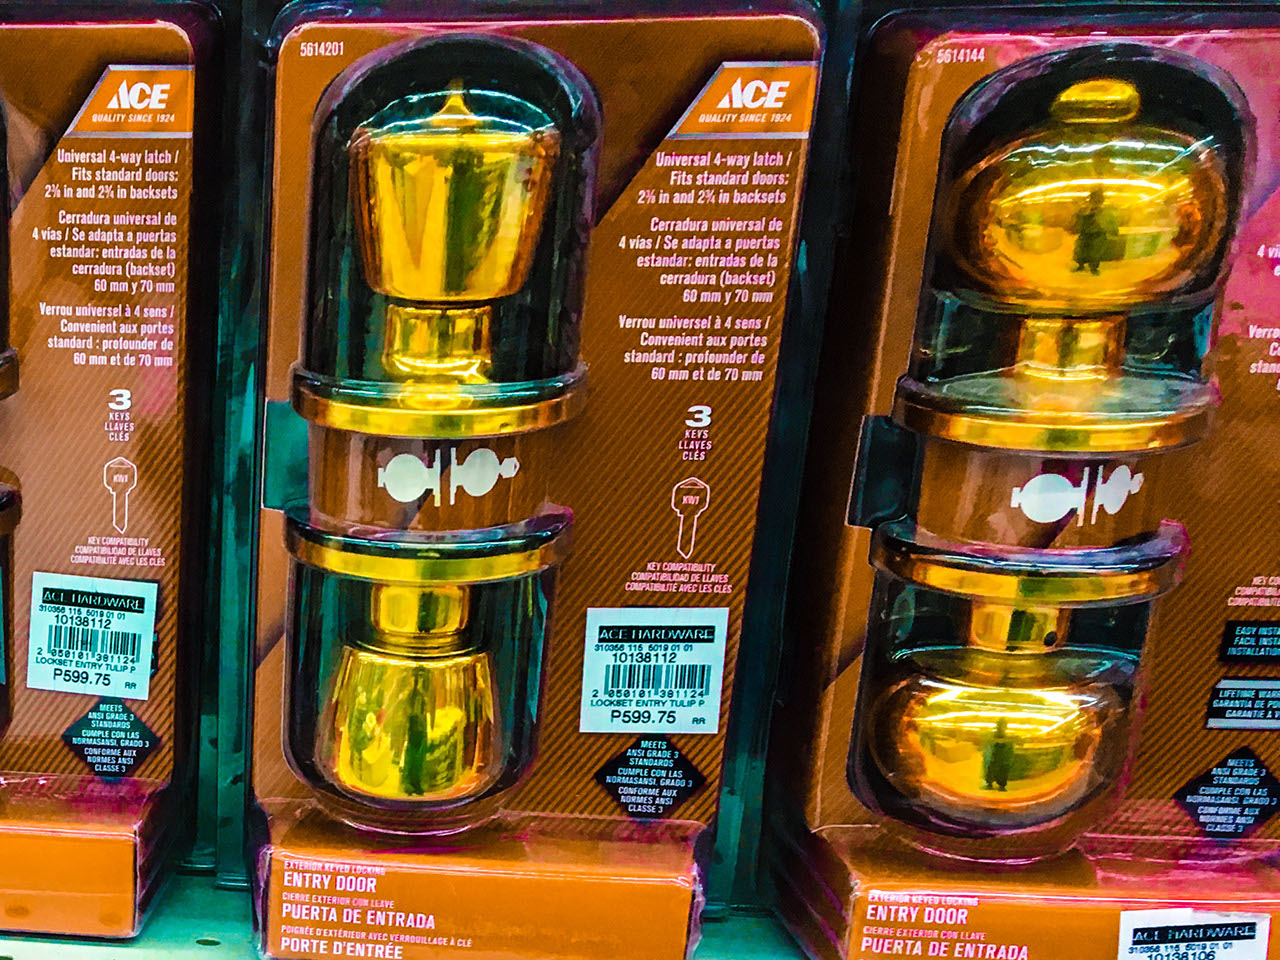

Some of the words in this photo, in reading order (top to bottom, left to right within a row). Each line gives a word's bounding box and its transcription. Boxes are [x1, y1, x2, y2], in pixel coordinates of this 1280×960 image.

[299, 41, 345, 57] 5614201
[936, 47, 985, 64] 5614144
[107, 79, 170, 109] ACE
[717, 78, 789, 108] ACE
[92, 113, 126, 122] QUALITY
[128, 114, 152, 122] SINCE
[156, 113, 175, 122] 1924
[699, 114, 736, 123] QUALITY
[739, 114, 766, 123] SINCE
[770, 114, 791, 123] 1924
[656, 151, 710, 167] Universal
[714, 152, 750, 169] 4-way
[753, 152, 783, 167] latch
[670, 171, 693, 185] Fits
[696, 172, 749, 186] standard
[752, 172, 789, 186] doors:
[659, 190, 670, 203] in
[673, 191, 694, 204] and
[719, 191, 730, 204] in
[733, 190, 786, 204] backsets
[651, 218, 708, 232] Cerradura
[711, 218, 766, 232] universal
[768, 218, 783, 232] de
[619, 236, 626, 249] 4
[664, 236, 678, 249] Se
[681, 236, 721, 252] adapta
[725, 239, 732, 250] a
[735, 237, 780, 252] puertas
[637, 254, 692, 268] estandar:
[696, 254, 746, 268] entradas
[750, 254, 764, 268] de
[767, 254, 778, 268] la
[660, 271, 716, 285] cerradura
[720, 271, 775, 287] (backset)
[683, 289, 697, 303] 60
[701, 292, 721, 303] mm
[724, 293, 731, 306] y
[735, 289, 749, 303] 70
[752, 292, 773, 303] mm
[40, 303, 73, 316] Verrou
[76, 303, 121, 317] universel
[134, 305, 140, 318] 4
[144, 307, 167, 318] sens
[60, 319, 116, 333] Convenient
[119, 323, 137, 334] aux
[140, 321, 174, 336] portes
[108, 389, 132, 410] 3
[685, 405, 711, 427] 3
[685, 429, 709, 440] KEYS
[679, 440, 712, 451] LLAVES
[55, 615, 111, 629] 10138112
[632, 629, 714, 639] HARDWARE
[612, 652, 677, 663] 10138112
[53, 668, 111, 686] P599.75
[611, 710, 676, 724] P599.75
[641, 741, 667, 749] MEETS
[646, 749, 672, 758] GRADE
[629, 758, 674, 767] STANDARDS
[284, 872, 331, 890] ENTRY
[335, 875, 377, 893] DOOR
[282, 903, 338, 922] PUERTA
[343, 908, 361, 923] DE
[366, 910, 435, 929] ENTRADA
[866, 905, 918, 923] ENTRY
[924, 907, 969, 925] DOOR
[281, 937, 328, 954] PORTE
[333, 941, 404, 959] D'ENTRÉE
[861, 937, 923, 955] PUERTA
[928, 941, 948, 956] DE
[953, 944, 1029, 960] ENTRADA
